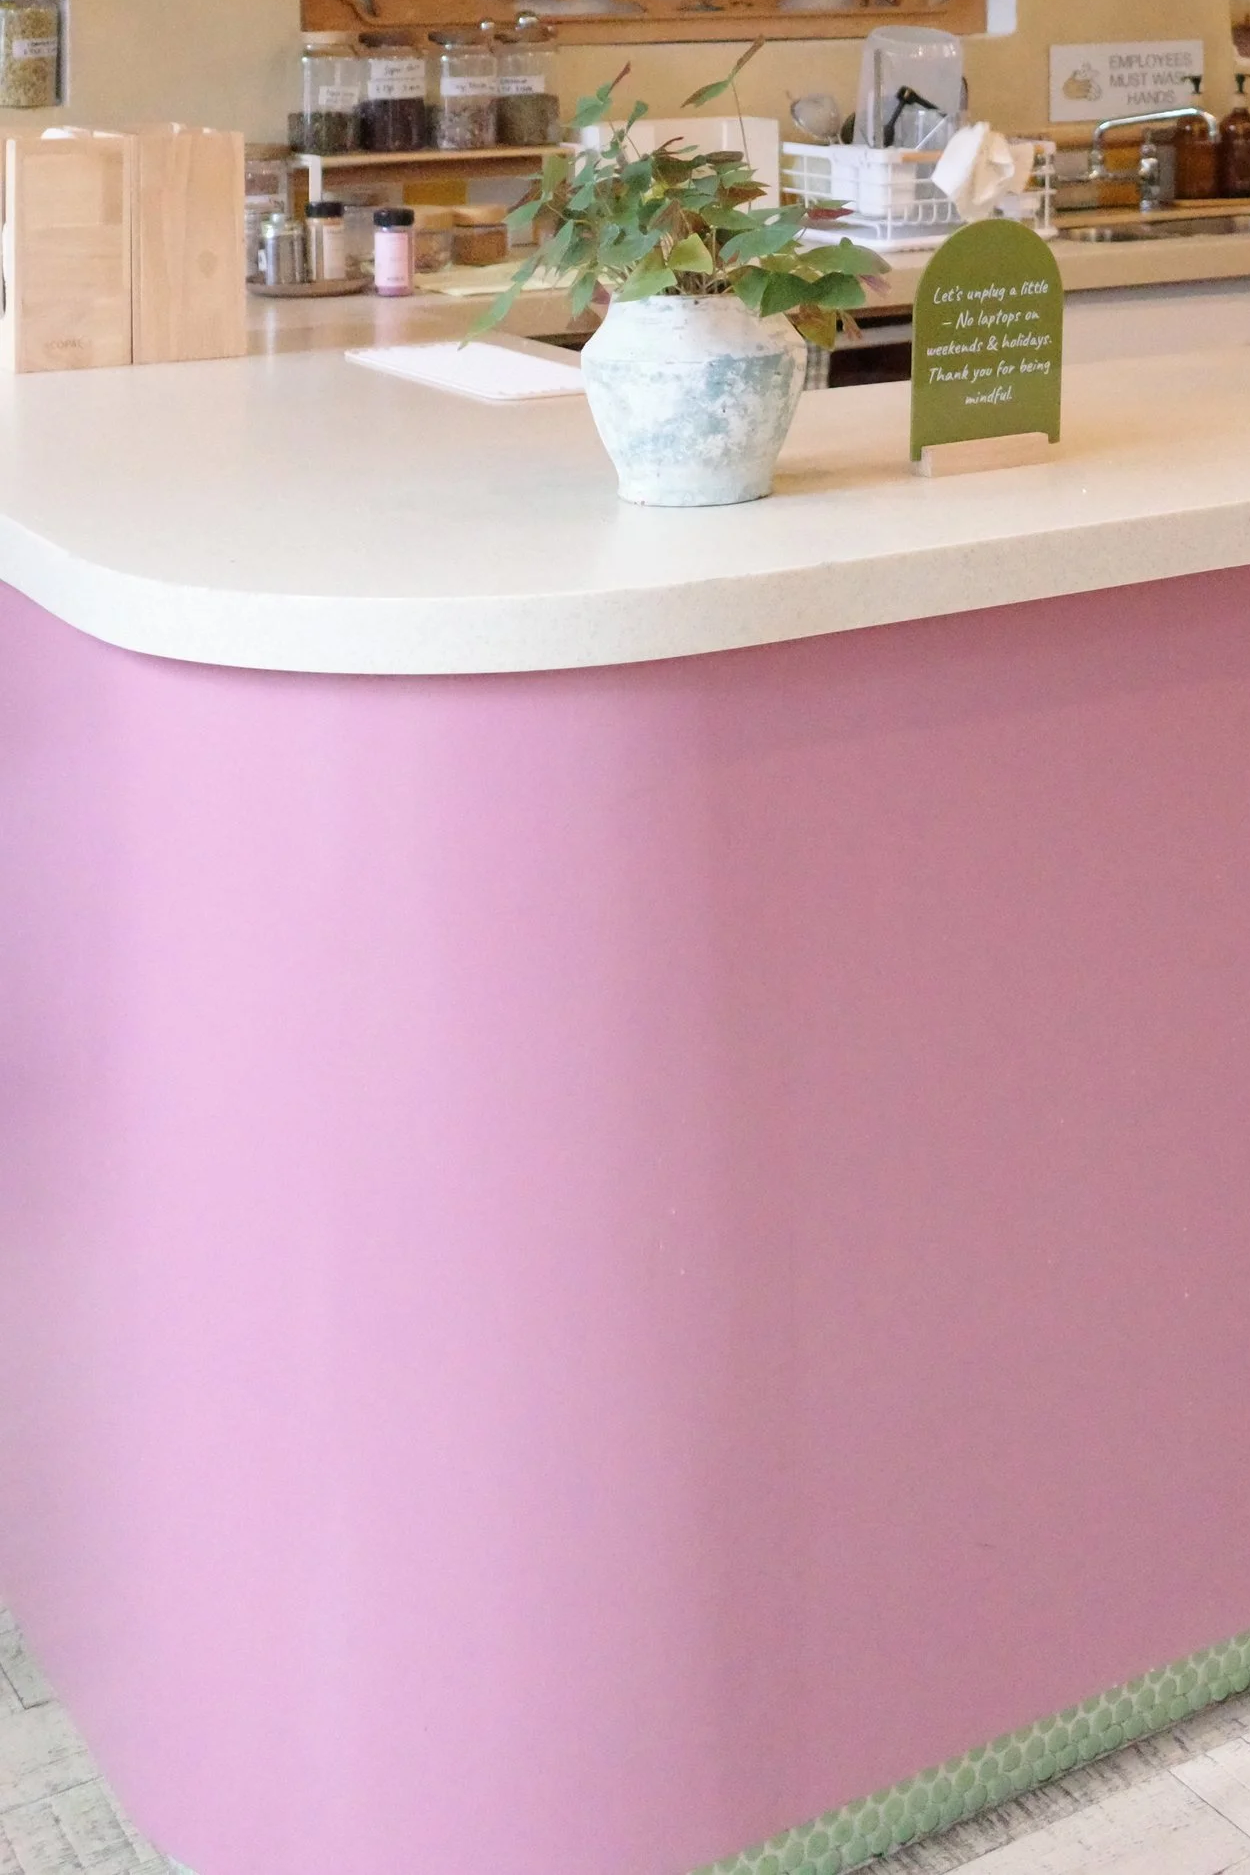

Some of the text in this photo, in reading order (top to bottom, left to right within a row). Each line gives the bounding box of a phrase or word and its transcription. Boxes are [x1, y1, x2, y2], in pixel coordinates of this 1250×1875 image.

[1108, 52, 1193, 69] EMPLOYEES
[1109, 73, 1149, 88] MUST
[1127, 90, 1176, 105] HANDS
[933, 279, 1048, 305] Let's unplug a little
[956, 313, 974, 330] No
[978, 311, 1020, 330] laptops
[1025, 312, 1040, 321] on
[926, 332, 1052, 357] weekends & holidays.
[928, 357, 1051, 384] Thank you for being
[965, 386, 1014, 405] mindful.
